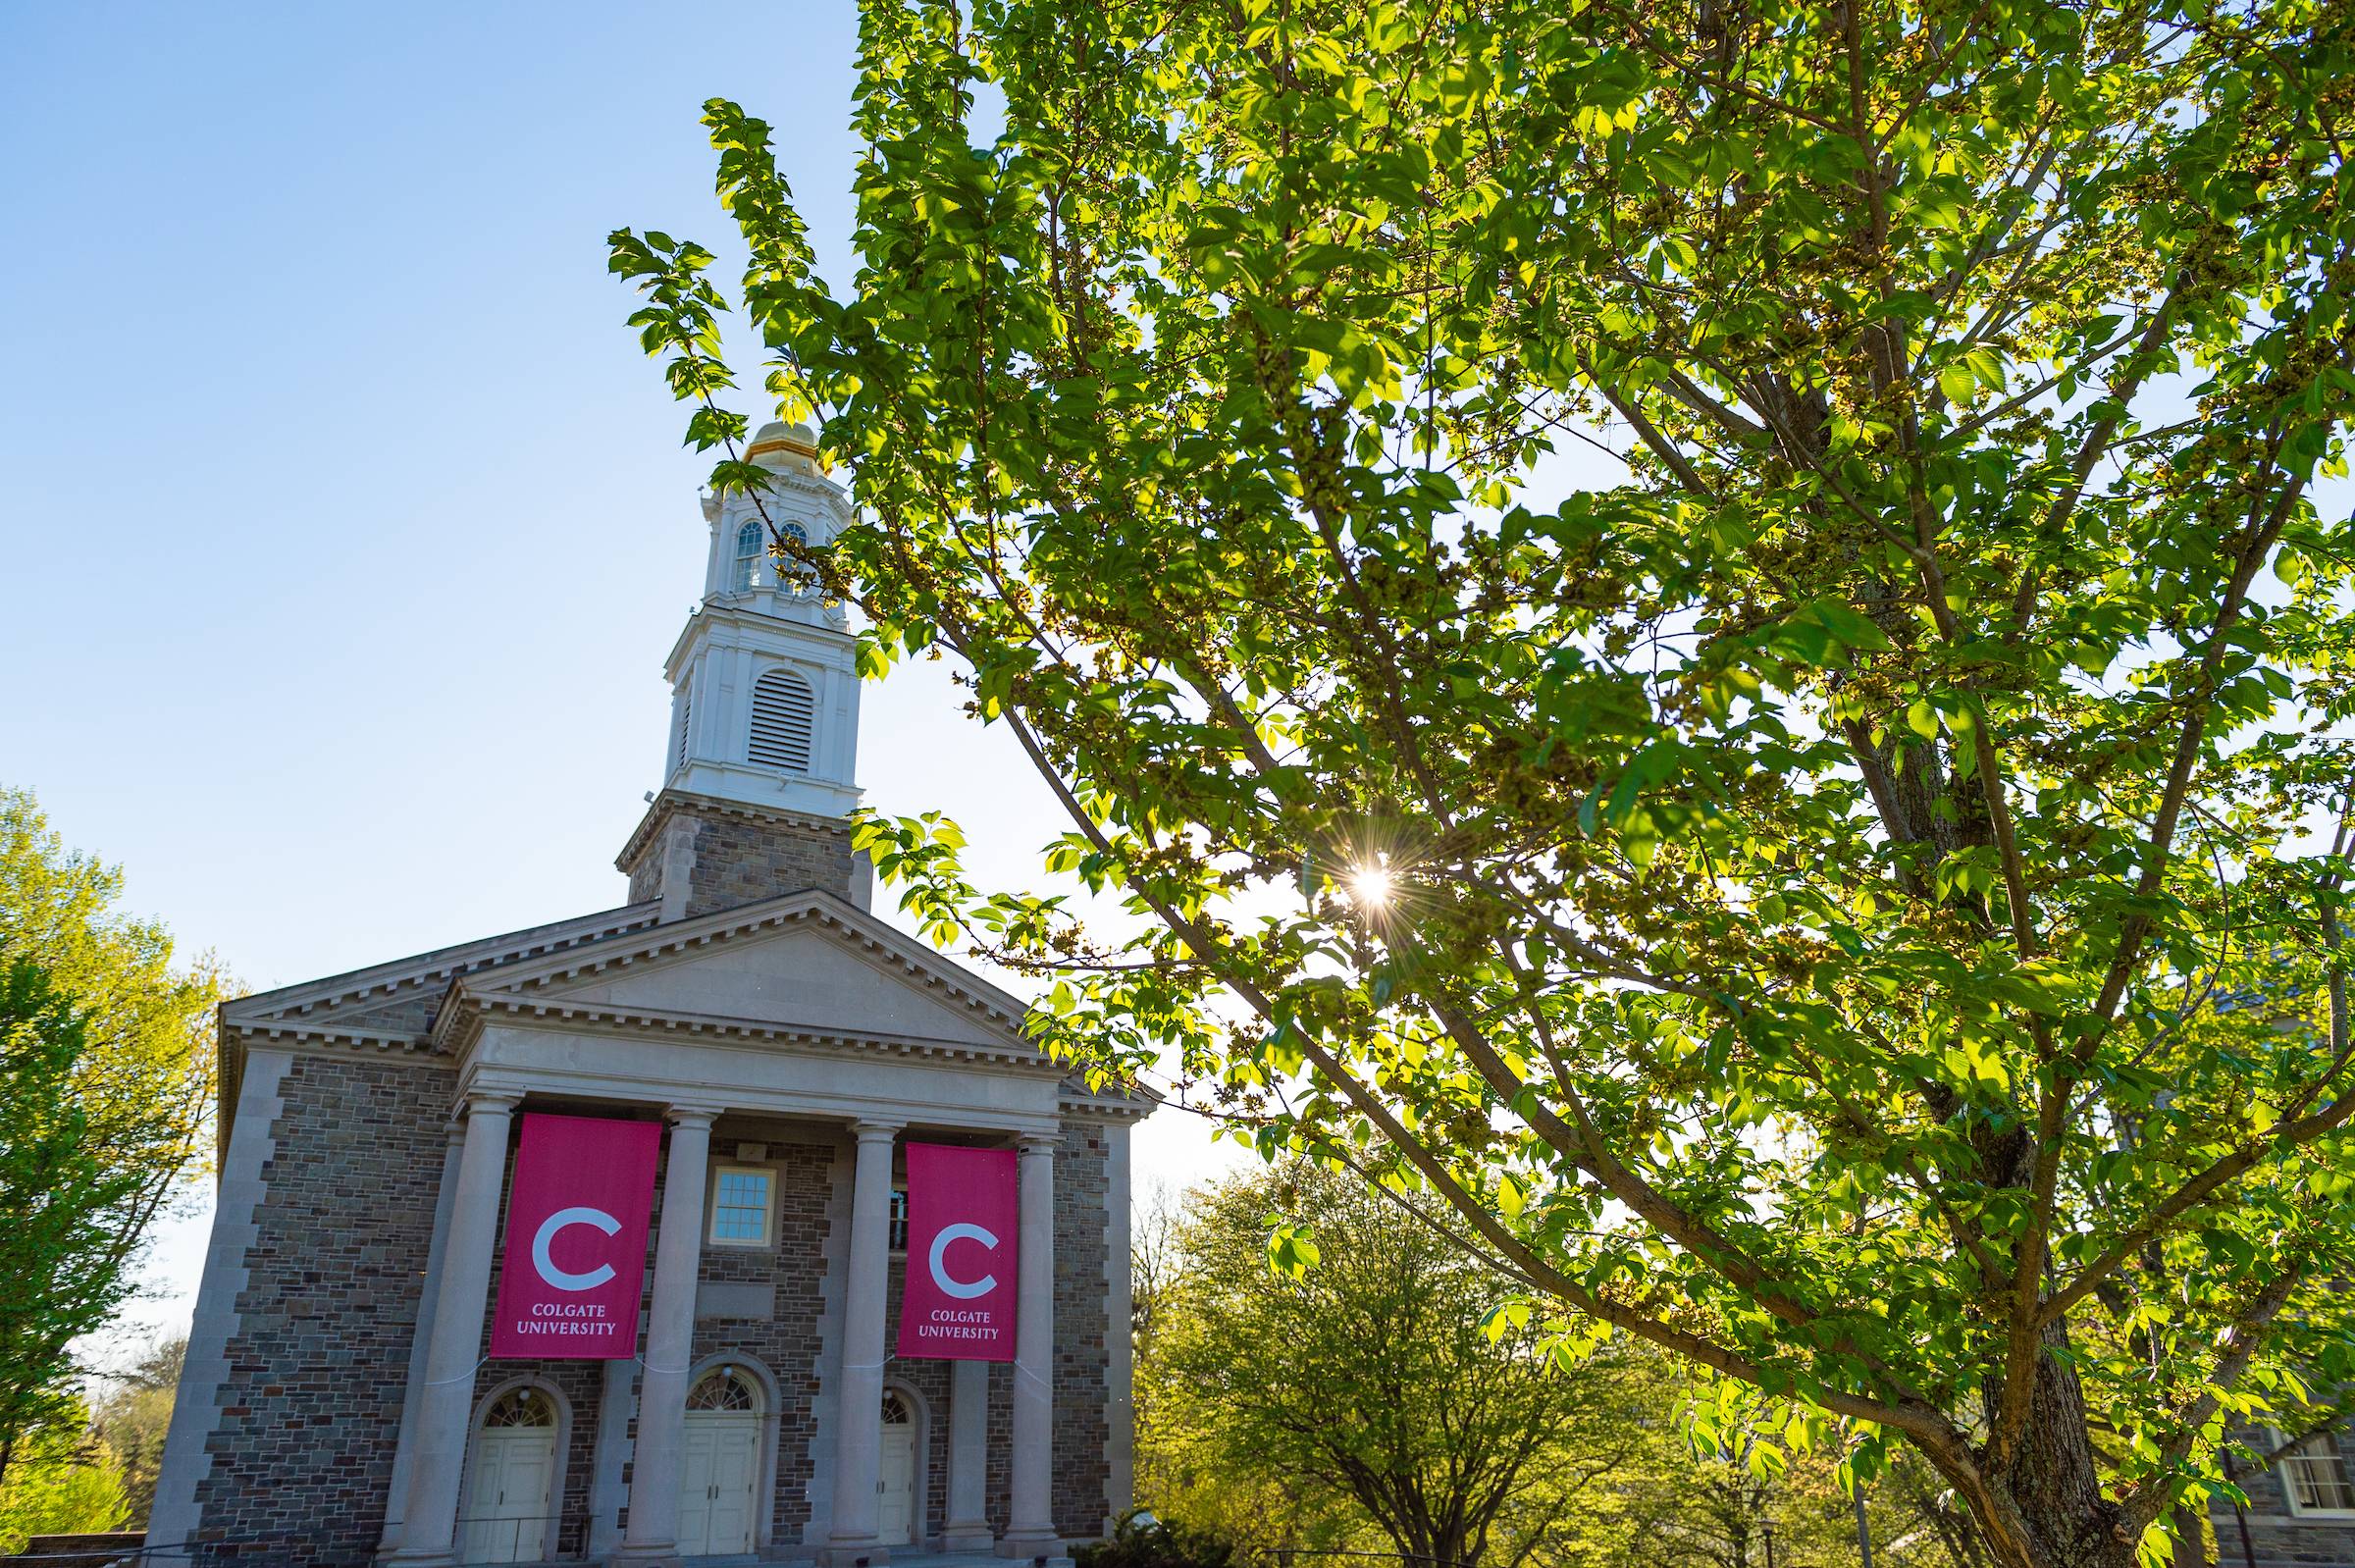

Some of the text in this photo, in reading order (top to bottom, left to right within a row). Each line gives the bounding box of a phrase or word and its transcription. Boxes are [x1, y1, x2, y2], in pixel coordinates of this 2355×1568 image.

[532, 1206, 622, 1291] C
[928, 1223, 1000, 1300] C
[532, 1303, 606, 1318] COLGATE
[931, 1309, 991, 1324] COLGATE
[517, 1321, 616, 1335] UNIVERSITY
[918, 1325, 1000, 1340] UNIVERSITY
